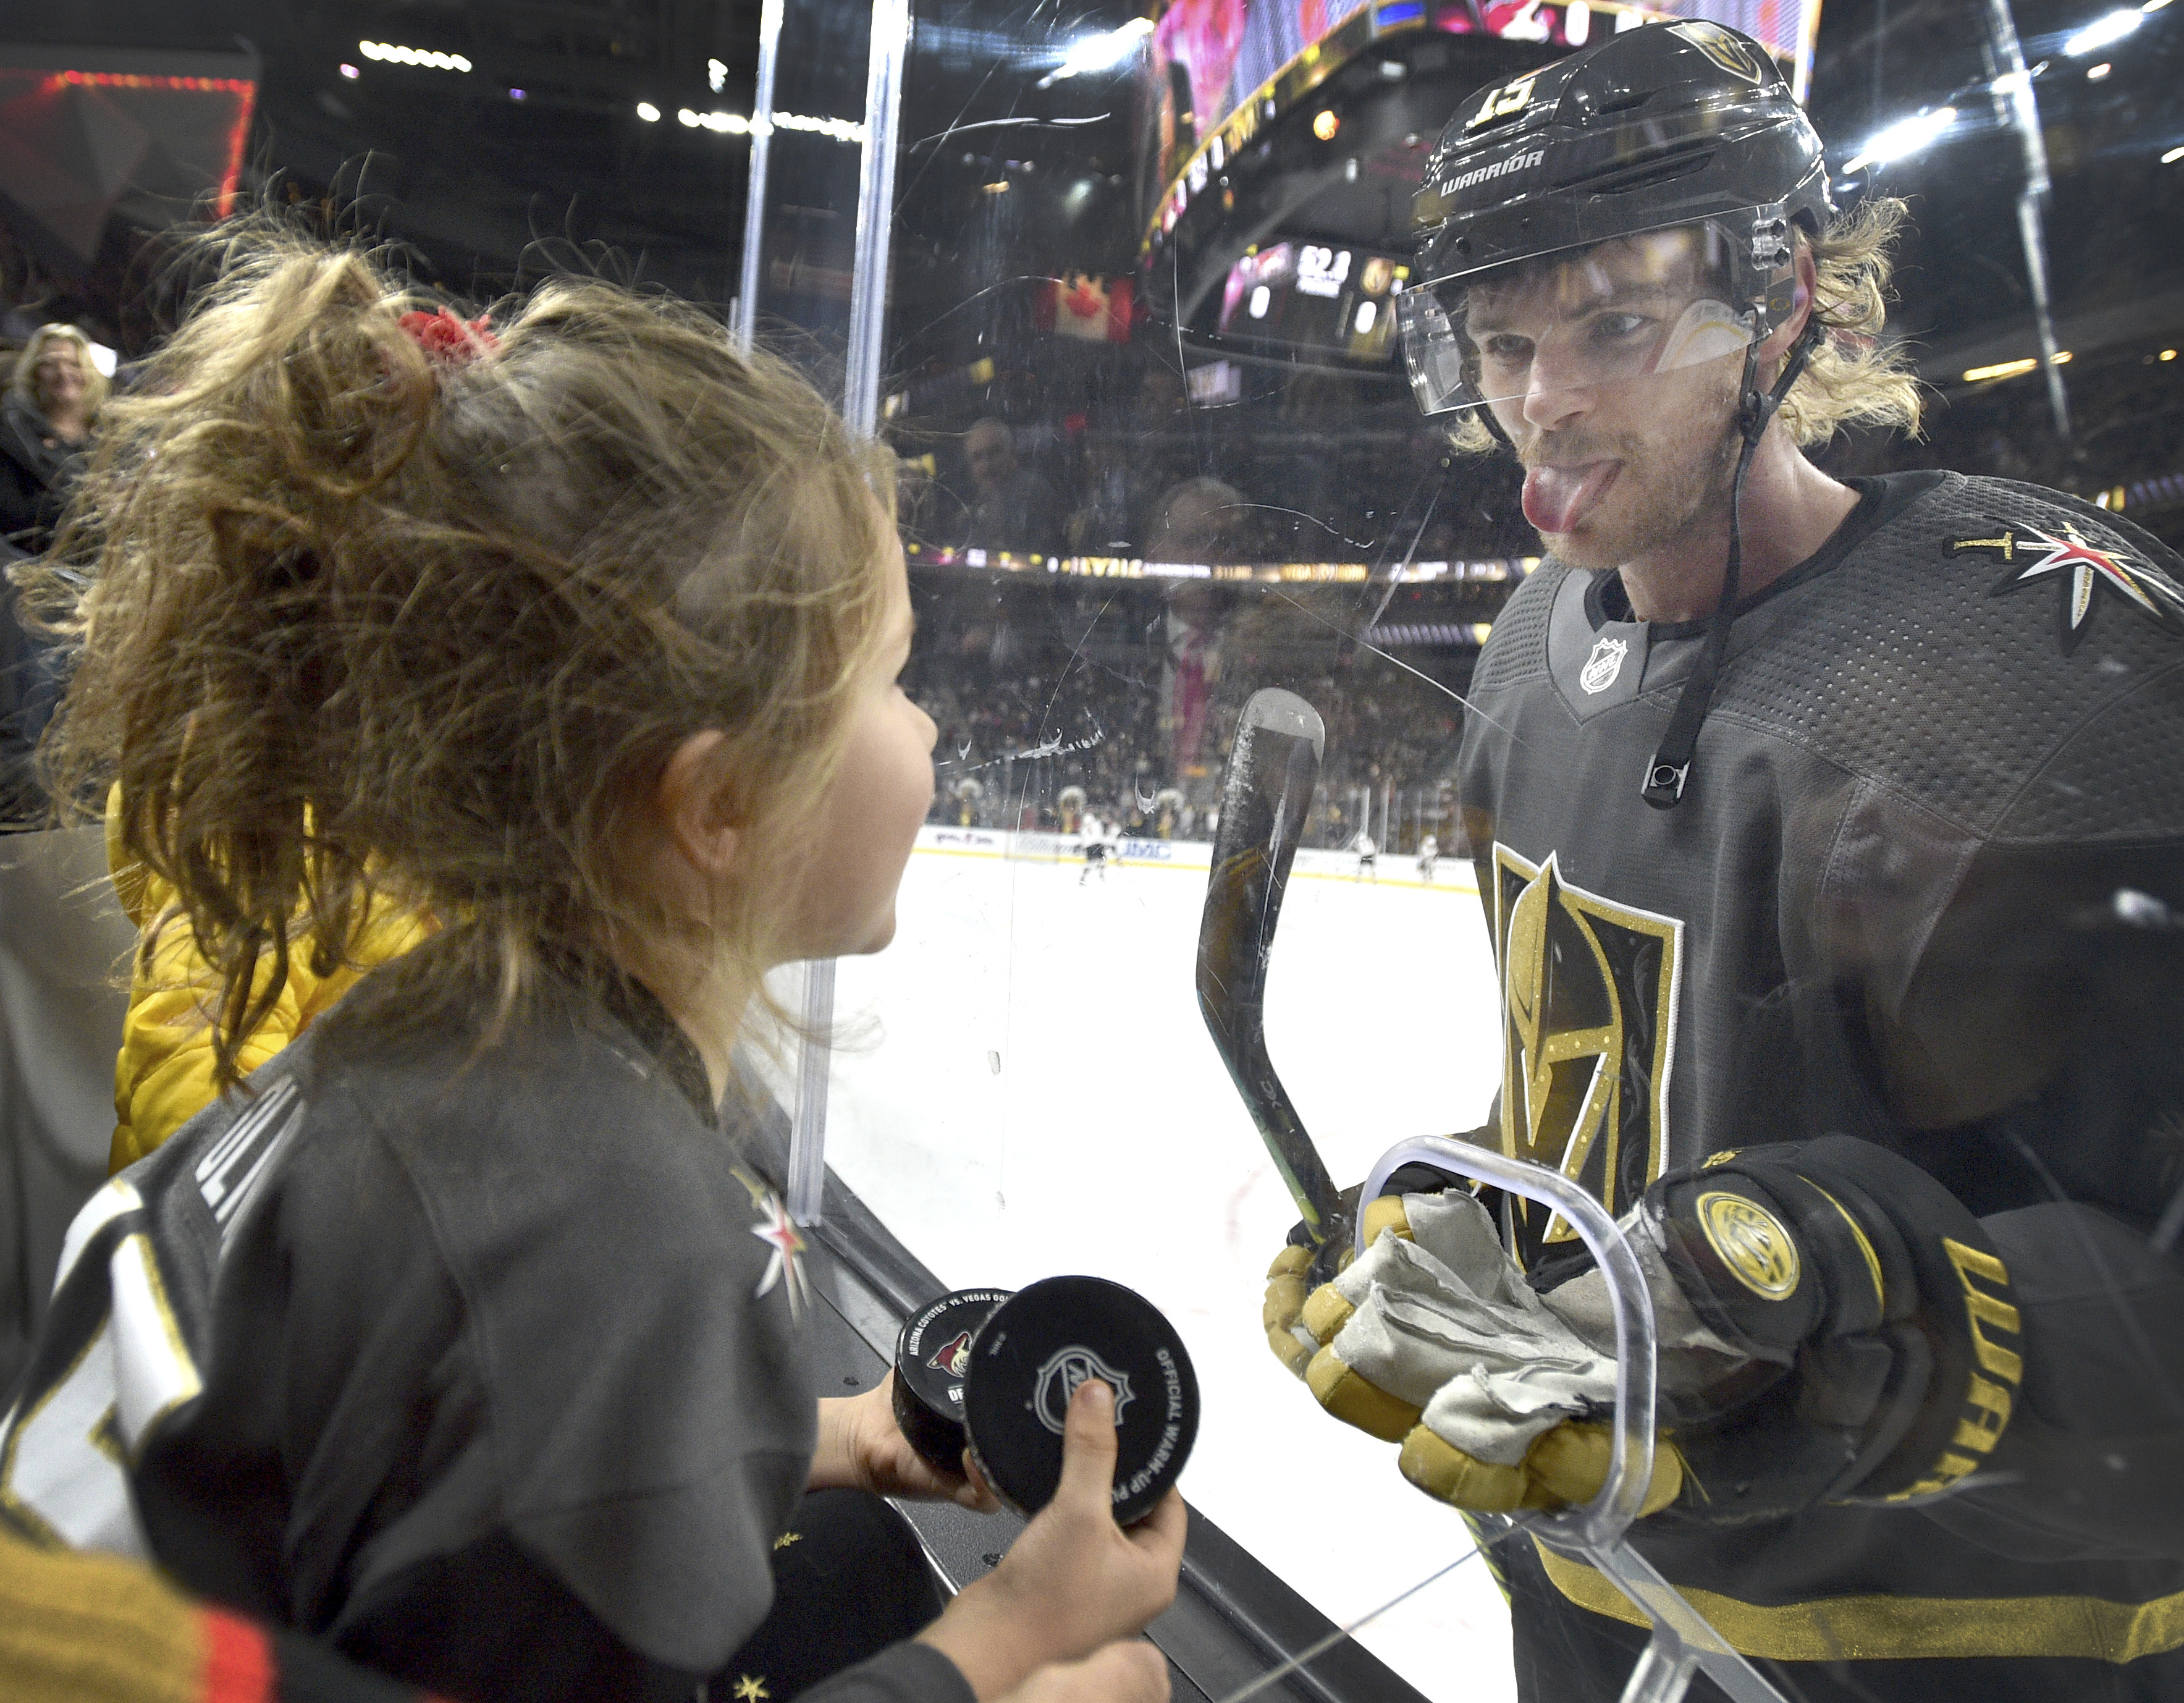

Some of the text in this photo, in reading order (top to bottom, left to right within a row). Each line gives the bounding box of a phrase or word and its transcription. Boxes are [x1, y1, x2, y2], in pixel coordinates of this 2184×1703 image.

[1473, 78, 1537, 127] 15
[1440, 150, 1545, 198] WARRIOR
[909, 1327, 924, 1356] ARIZONA
[948, 1298, 963, 1308] VS.
[962, 1294, 991, 1303] VEGAS
[1155, 1347, 1183, 1422] OFFICIAL
[1130, 1422, 1181, 1494] WARM-UP
